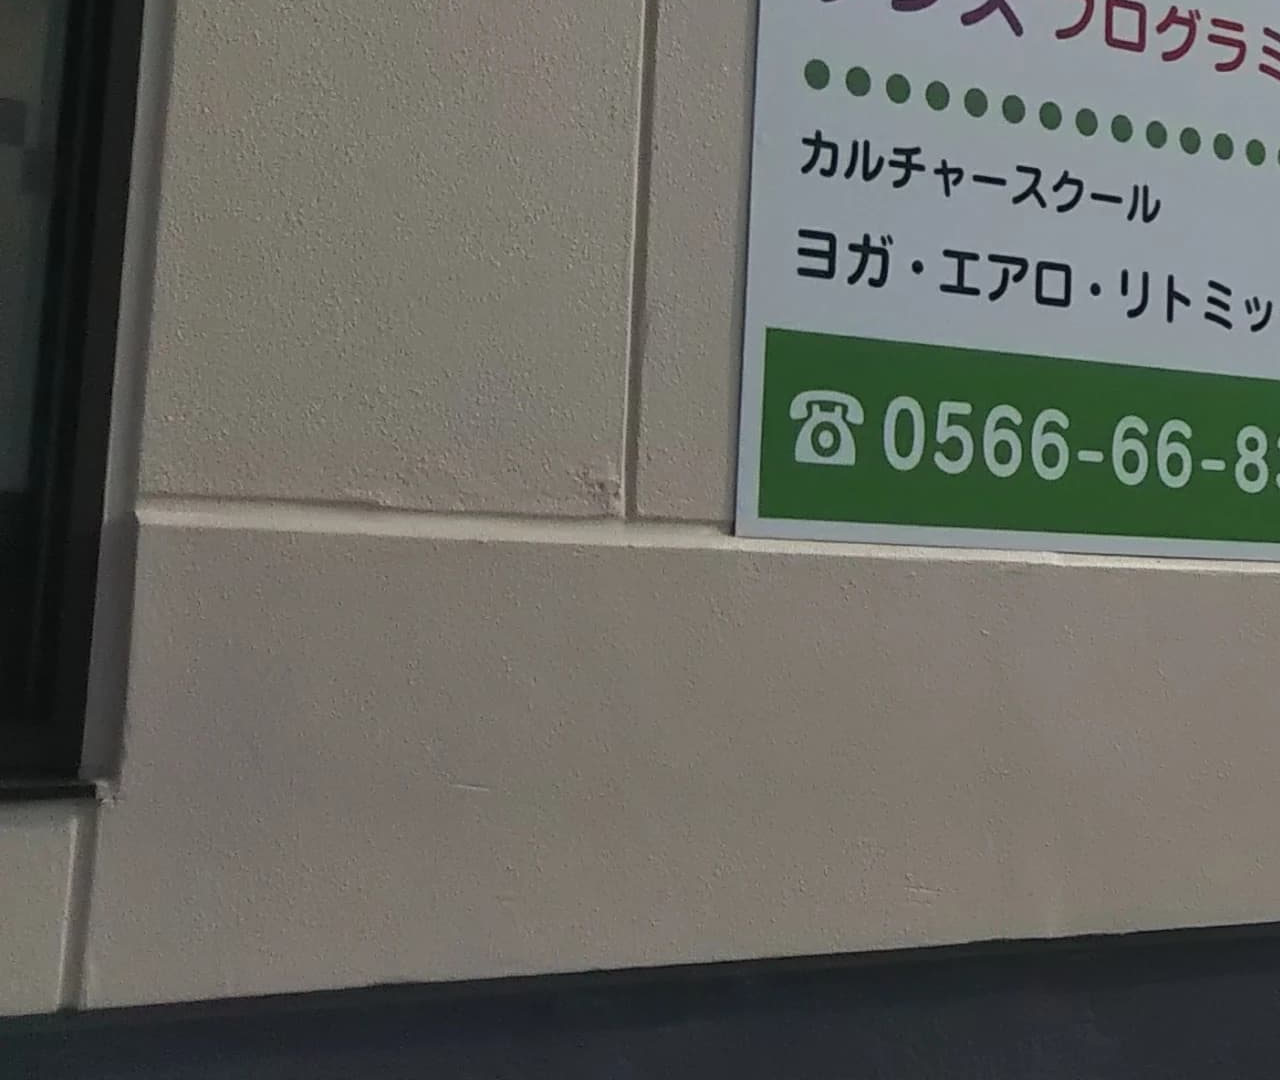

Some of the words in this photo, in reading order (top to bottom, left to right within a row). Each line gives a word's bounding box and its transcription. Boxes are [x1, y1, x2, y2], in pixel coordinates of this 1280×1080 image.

[800, 130, 1161, 224] カルチャースクール
